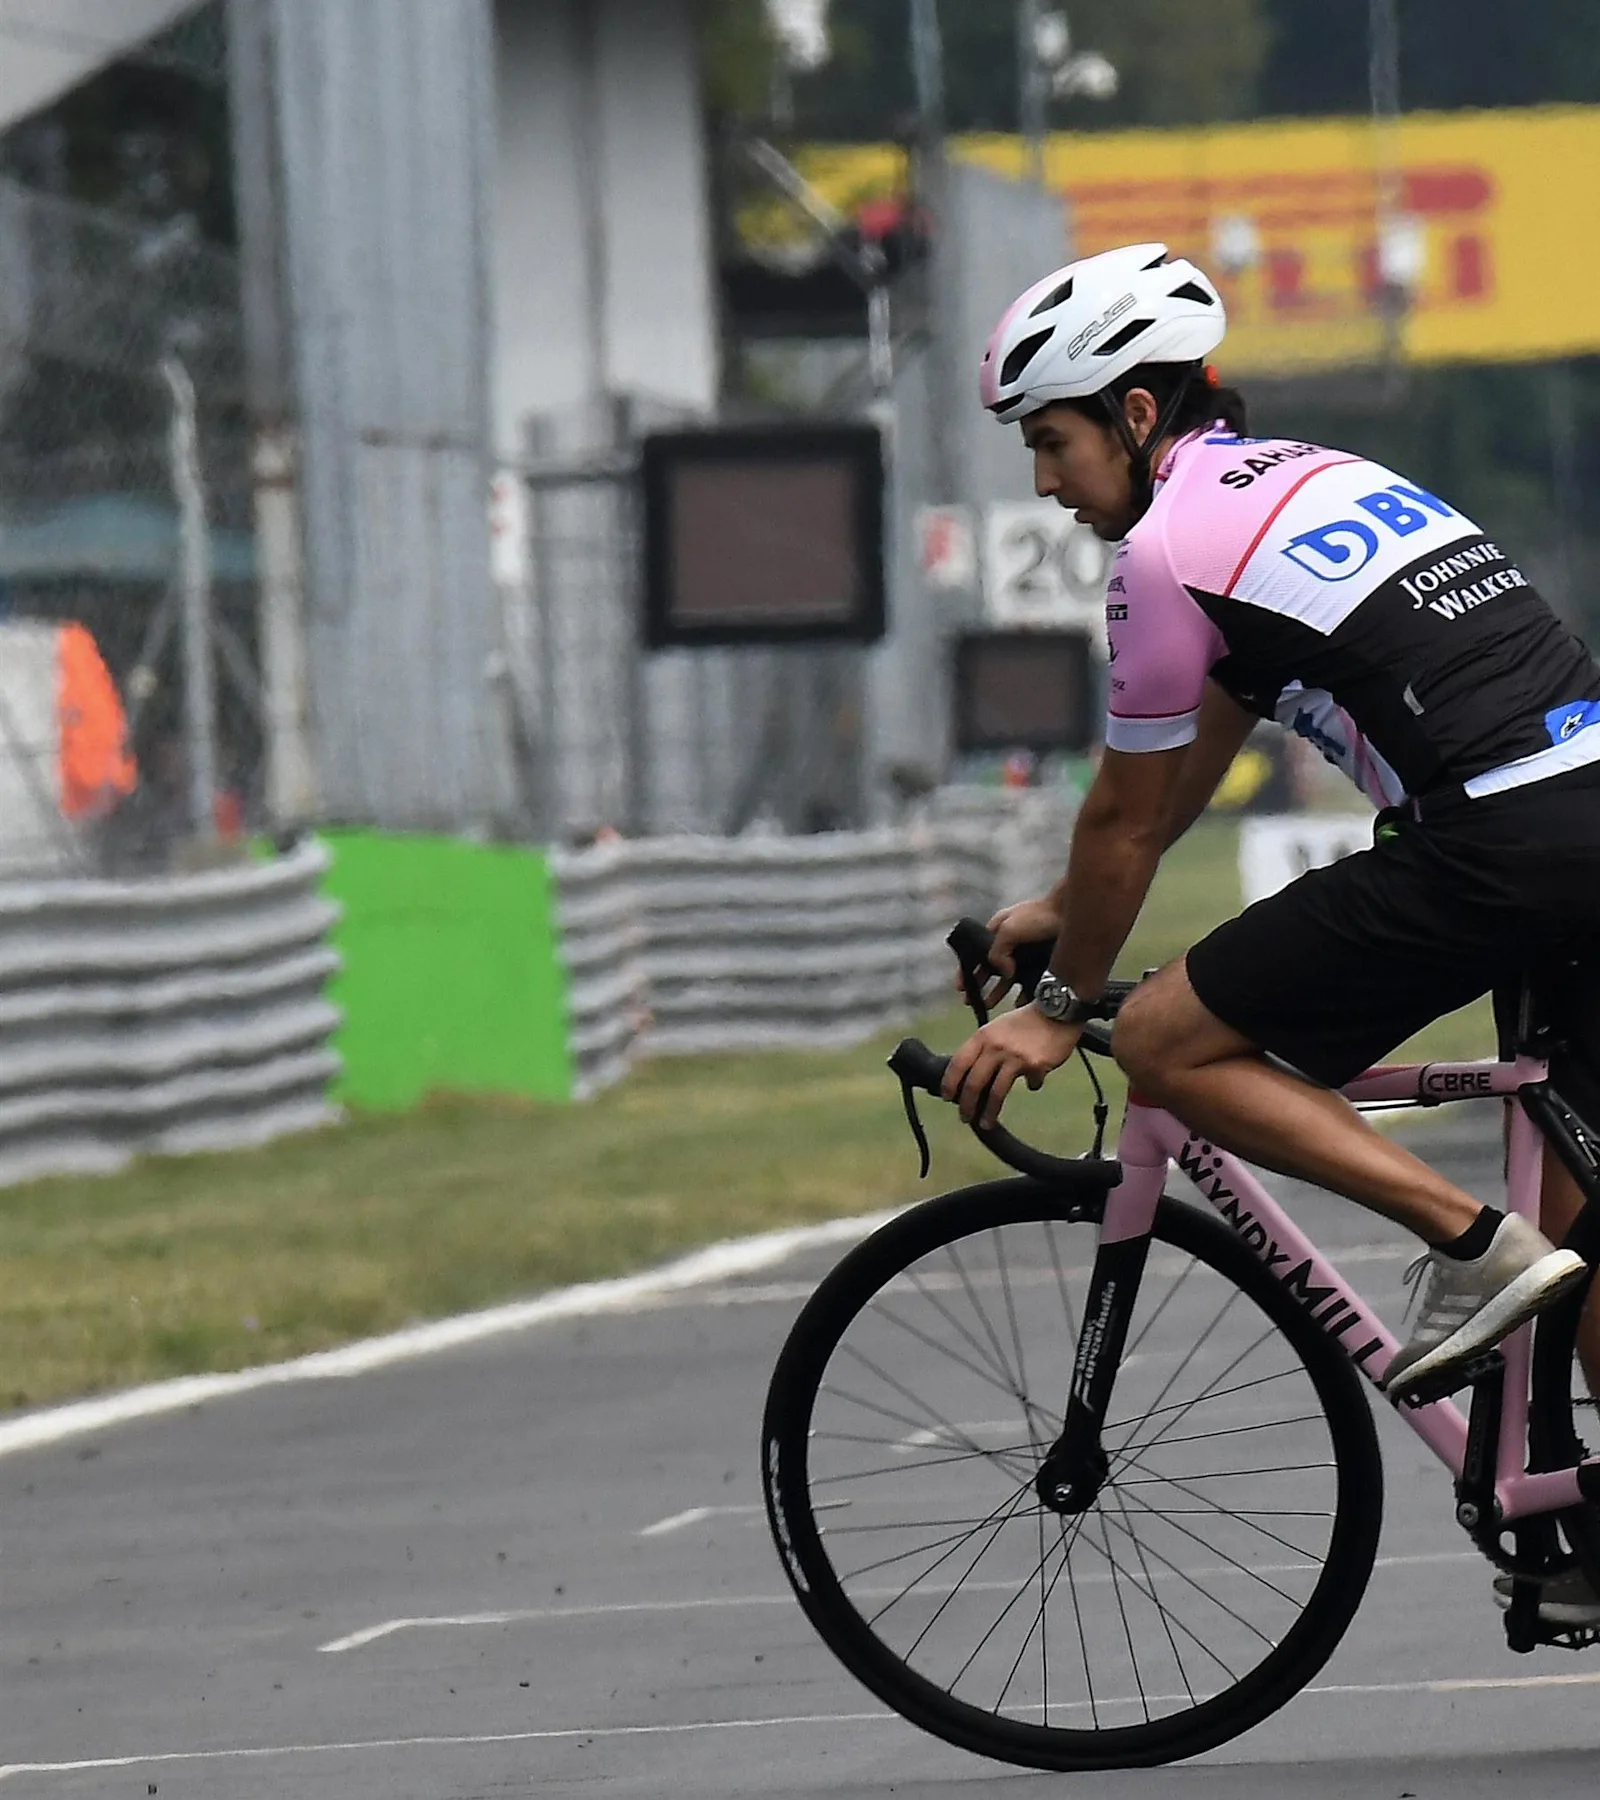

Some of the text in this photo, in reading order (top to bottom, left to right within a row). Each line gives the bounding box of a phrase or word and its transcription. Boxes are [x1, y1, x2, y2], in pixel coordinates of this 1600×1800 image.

[1398, 541, 1506, 610] JOHNNIE
[1428, 563, 1530, 621] WALKER
[1427, 1072, 1492, 1093] CBRE
[1281, 1258, 1390, 1391] MILL
